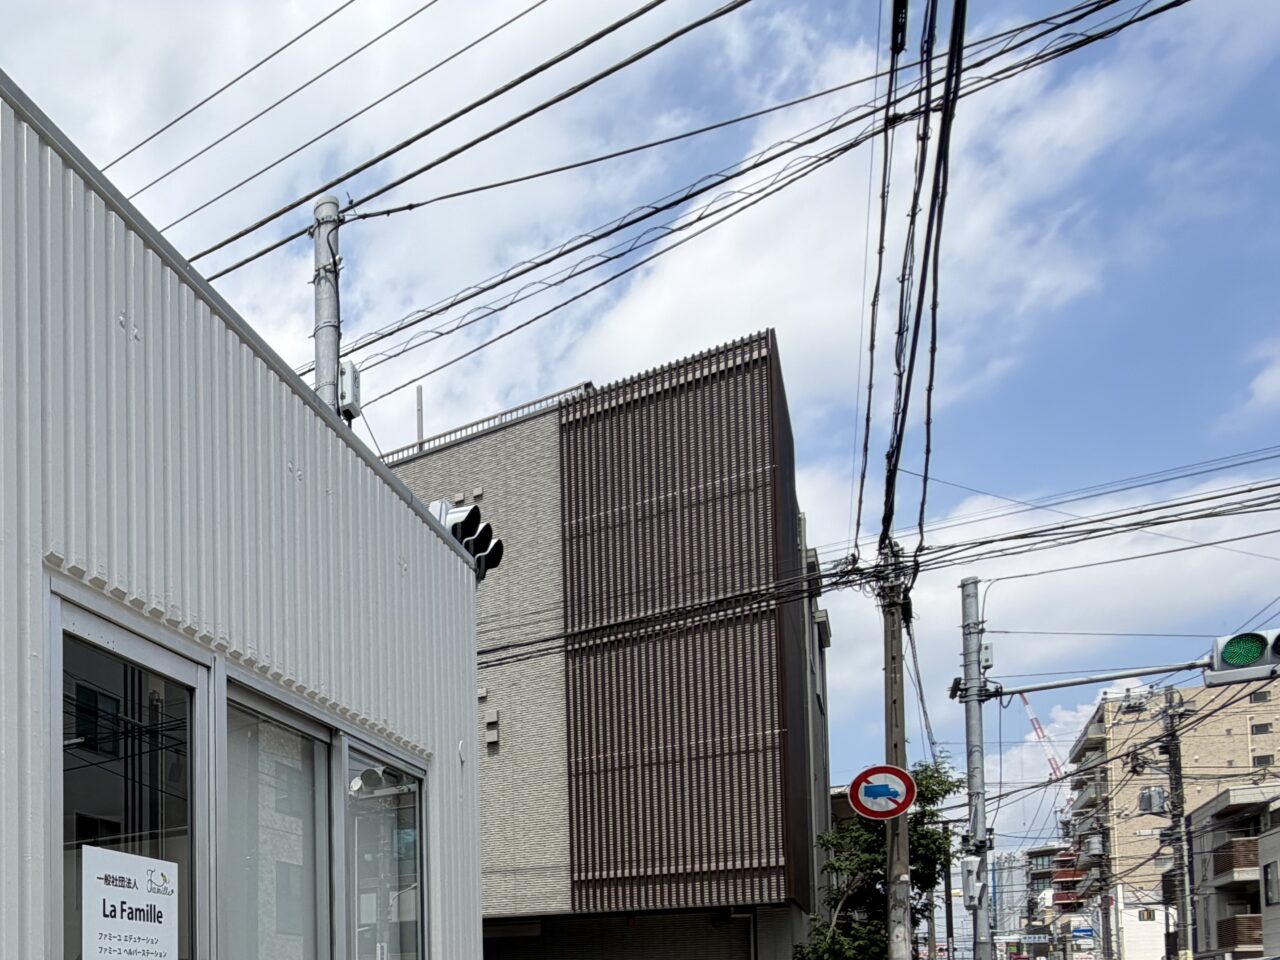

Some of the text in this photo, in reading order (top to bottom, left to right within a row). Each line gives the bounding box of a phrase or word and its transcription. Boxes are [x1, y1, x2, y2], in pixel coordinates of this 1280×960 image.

[96, 874, 139, 890] 一般社団法人
[102, 898, 163, 924] La Famille
